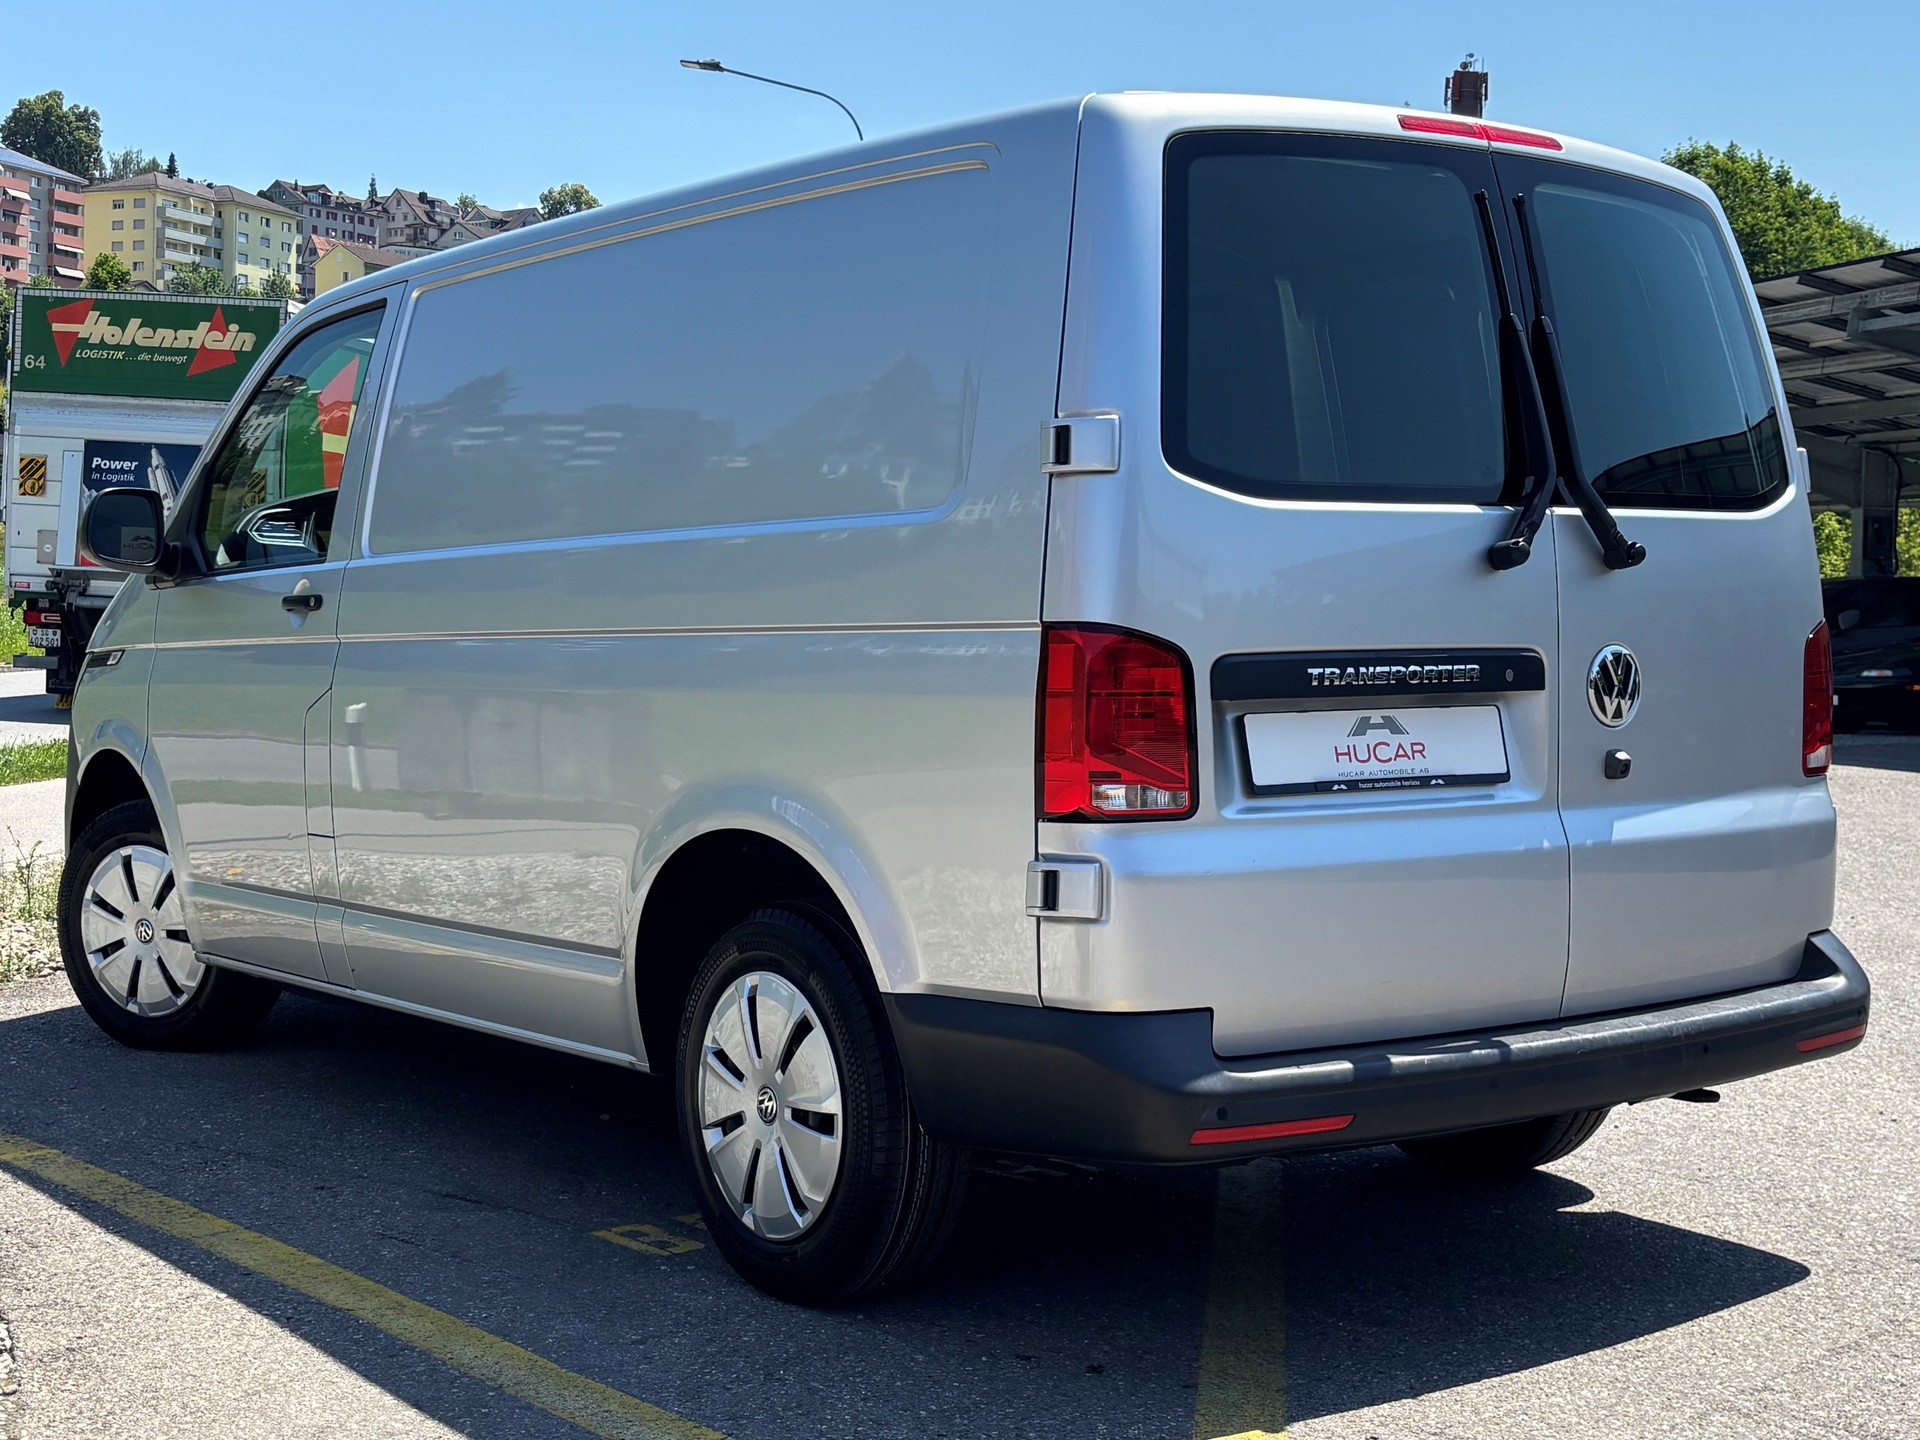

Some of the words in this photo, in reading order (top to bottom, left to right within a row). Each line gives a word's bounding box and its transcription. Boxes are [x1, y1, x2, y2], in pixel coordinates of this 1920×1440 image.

[52, 311, 256, 351] Holenstein
[24, 354, 46, 369] 64
[75, 349, 125, 360] LOGISTIK
[137, 352, 152, 361] die
[153, 353, 187, 364] bewegt
[91, 457, 139, 470] Power
[91, 471, 101, 480] in
[102, 472, 135, 483] Logistik
[1308, 664, 1481, 687] TRANSPORTER
[1334, 741, 1426, 764] HUCAR
[1338, 770, 1365, 778] HUCAR
[1369, 768, 1416, 776] AUTOMOBILE
